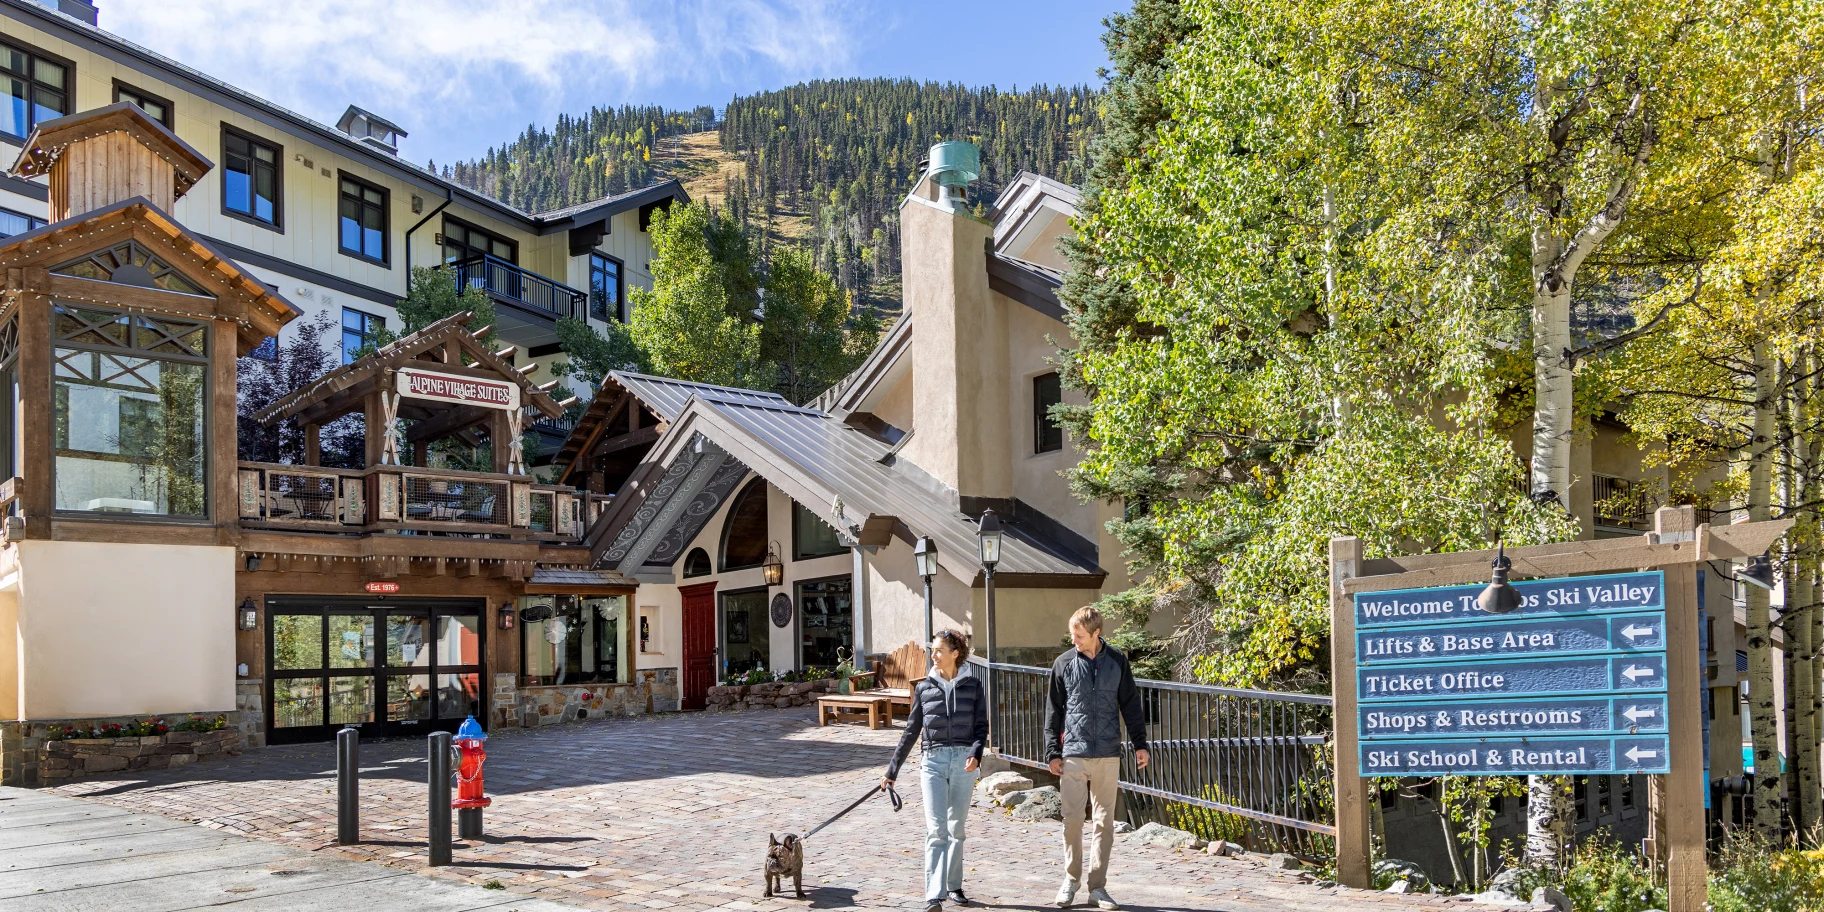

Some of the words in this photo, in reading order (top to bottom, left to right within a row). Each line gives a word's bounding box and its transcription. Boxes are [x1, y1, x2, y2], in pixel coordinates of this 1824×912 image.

[409, 376, 444, 394] ALPINE
[444, 381, 476, 400] VILLAGE
[477, 385, 512, 403] SUITES
[382, 583, 395, 591] 1976
[1362, 600, 1454, 618] Welcome
[1546, 587, 1581, 606] Ski
[1586, 583, 1656, 605] Valley
[1366, 637, 1413, 656] Lifts
[1419, 636, 1436, 652] &
[1443, 635, 1494, 651] Base
[1501, 631, 1555, 648] Area
[1366, 674, 1434, 693] Ticket
[1441, 671, 1505, 690] Office
[1367, 711, 1427, 732] Shops
[1436, 710, 1452, 727] &
[1461, 709, 1582, 726] Restrooms
[1368, 750, 1400, 768] Ski
[1408, 749, 1478, 767] School
[1486, 749, 1504, 766] &
[1511, 747, 1587, 765] Rental
